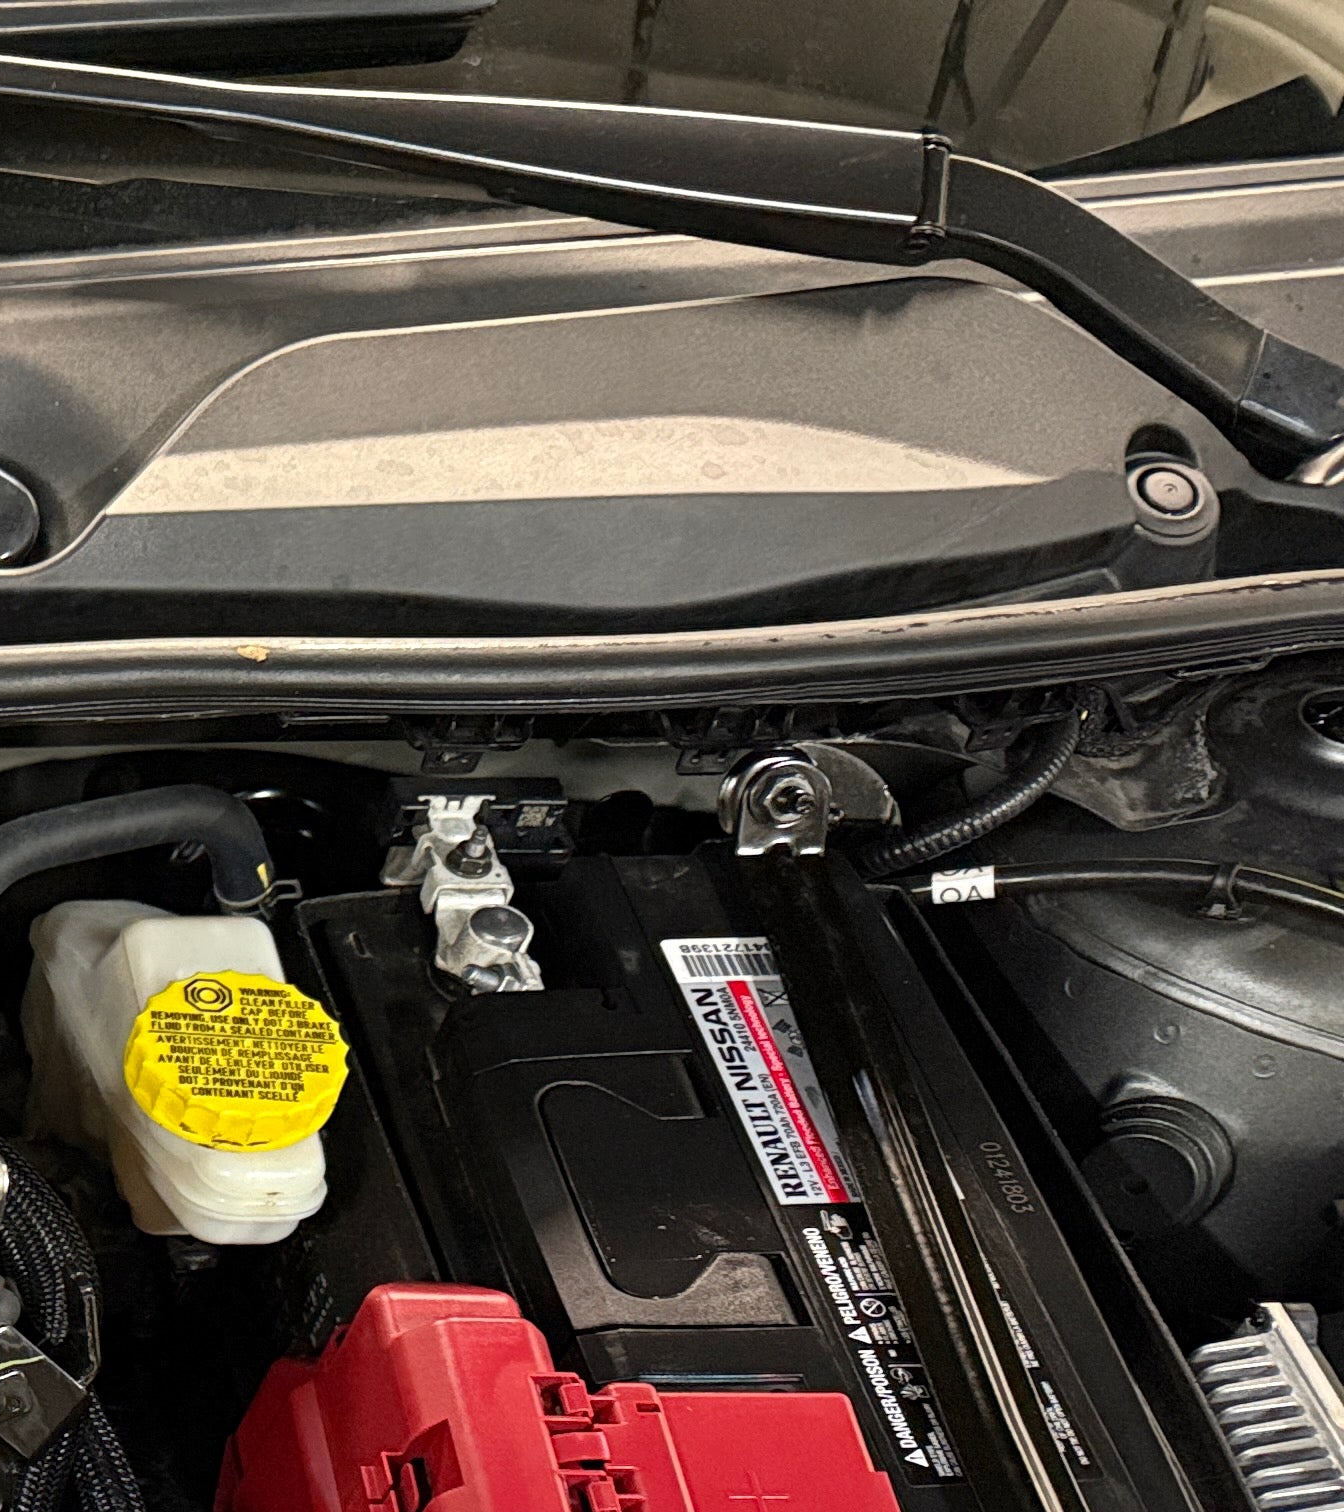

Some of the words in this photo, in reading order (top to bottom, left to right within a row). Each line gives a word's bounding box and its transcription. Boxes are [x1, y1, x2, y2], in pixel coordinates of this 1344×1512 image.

[239, 988, 291, 998] WARNING:
[240, 998, 276, 1008] CLEAN
[278, 999, 315, 1010] FILLER
[241, 1008, 263, 1016] CAP
[268, 1009, 307, 1019] BEFORE
[151, 1021, 181, 1030] FLUID
[186, 1023, 215, 1033] FROM
[219, 1025, 227, 1034] A
[230, 1026, 273, 1036] SEALED
[276, 1029, 335, 1041] CONTAINER
[210, 1015, 229, 1024] USE
[232, 1016, 259, 1026] ONLY
[264, 1018, 283, 1027] DOT
[287, 1019, 294, 1028] 3
[296, 1020, 332, 1031] BRAKE
[691, 988, 758, 1091] NISSAN
[733, 1023, 757, 1052] 24410
[170, 1045, 218, 1056] BOUCHON
[222, 1048, 233, 1057] DE
[238, 1049, 313, 1062] REMPLISSAGE
[252, 1040, 308, 1051] NETTOYER
[310, 1044, 324, 1053] LE
[158, 1054, 196, 1064] AVANT
[200, 1056, 213, 1065] DE
[179, 1066, 241, 1077] SEULEMENT
[246, 1069, 259, 1078] DU
[179, 1076, 199, 1085] DOT
[203, 1077, 210, 1085] 3
[213, 1078, 277, 1090] PROVENANT
[191, 1087, 254, 1099] CONTENANT
[742, 1100, 809, 1198] RENAULT
[980, 1142, 1036, 1214] 01241803
[802, 1227, 861, 1325] PELIGRO/VENENO
[858, 1350, 918, 1449] DANGER/POISON
